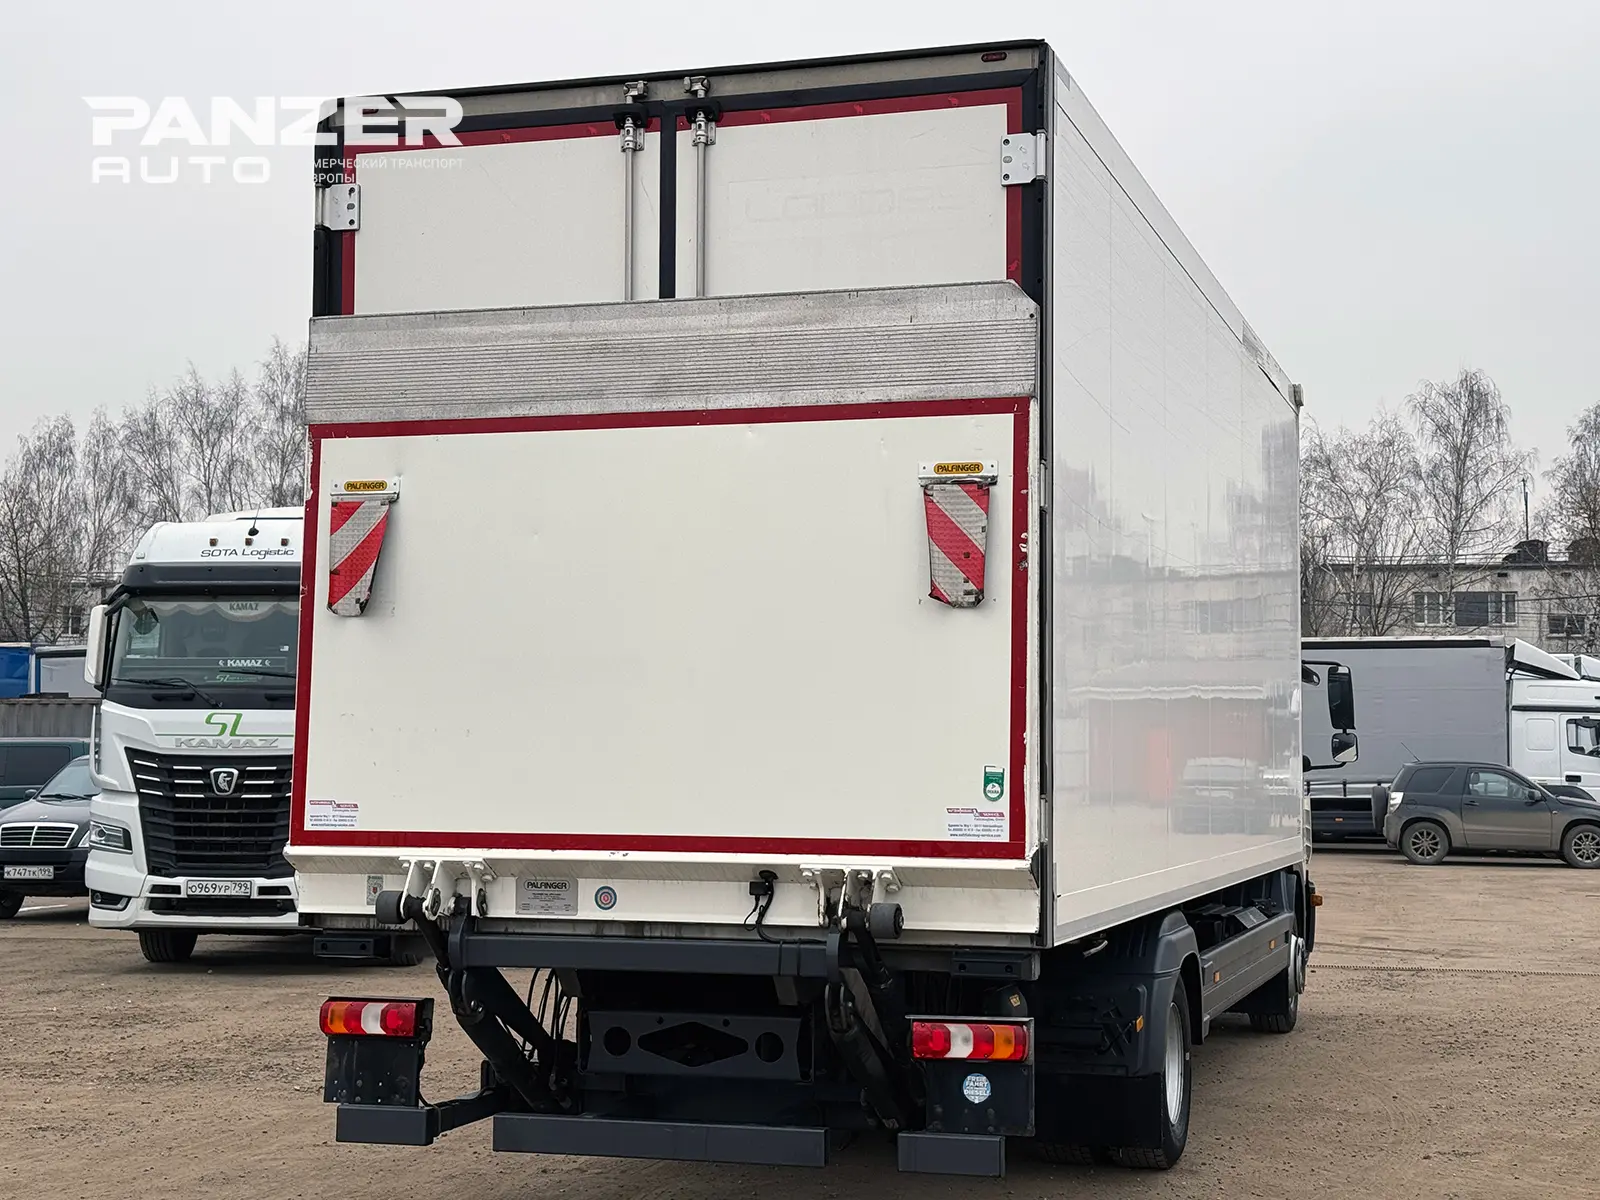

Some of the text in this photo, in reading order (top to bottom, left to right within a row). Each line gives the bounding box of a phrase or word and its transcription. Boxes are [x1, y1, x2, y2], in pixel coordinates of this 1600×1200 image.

[937, 464, 980, 472] PALFINGER
[346, 482, 385, 490] PALFINGER
[200, 548, 295, 560] SOTA Logistic
[229, 602, 260, 611] KAMAZ
[227, 659, 263, 667] KAMAZ
[175, 738, 279, 748] KAMAZ
[527, 881, 567, 890] PALFINGER
